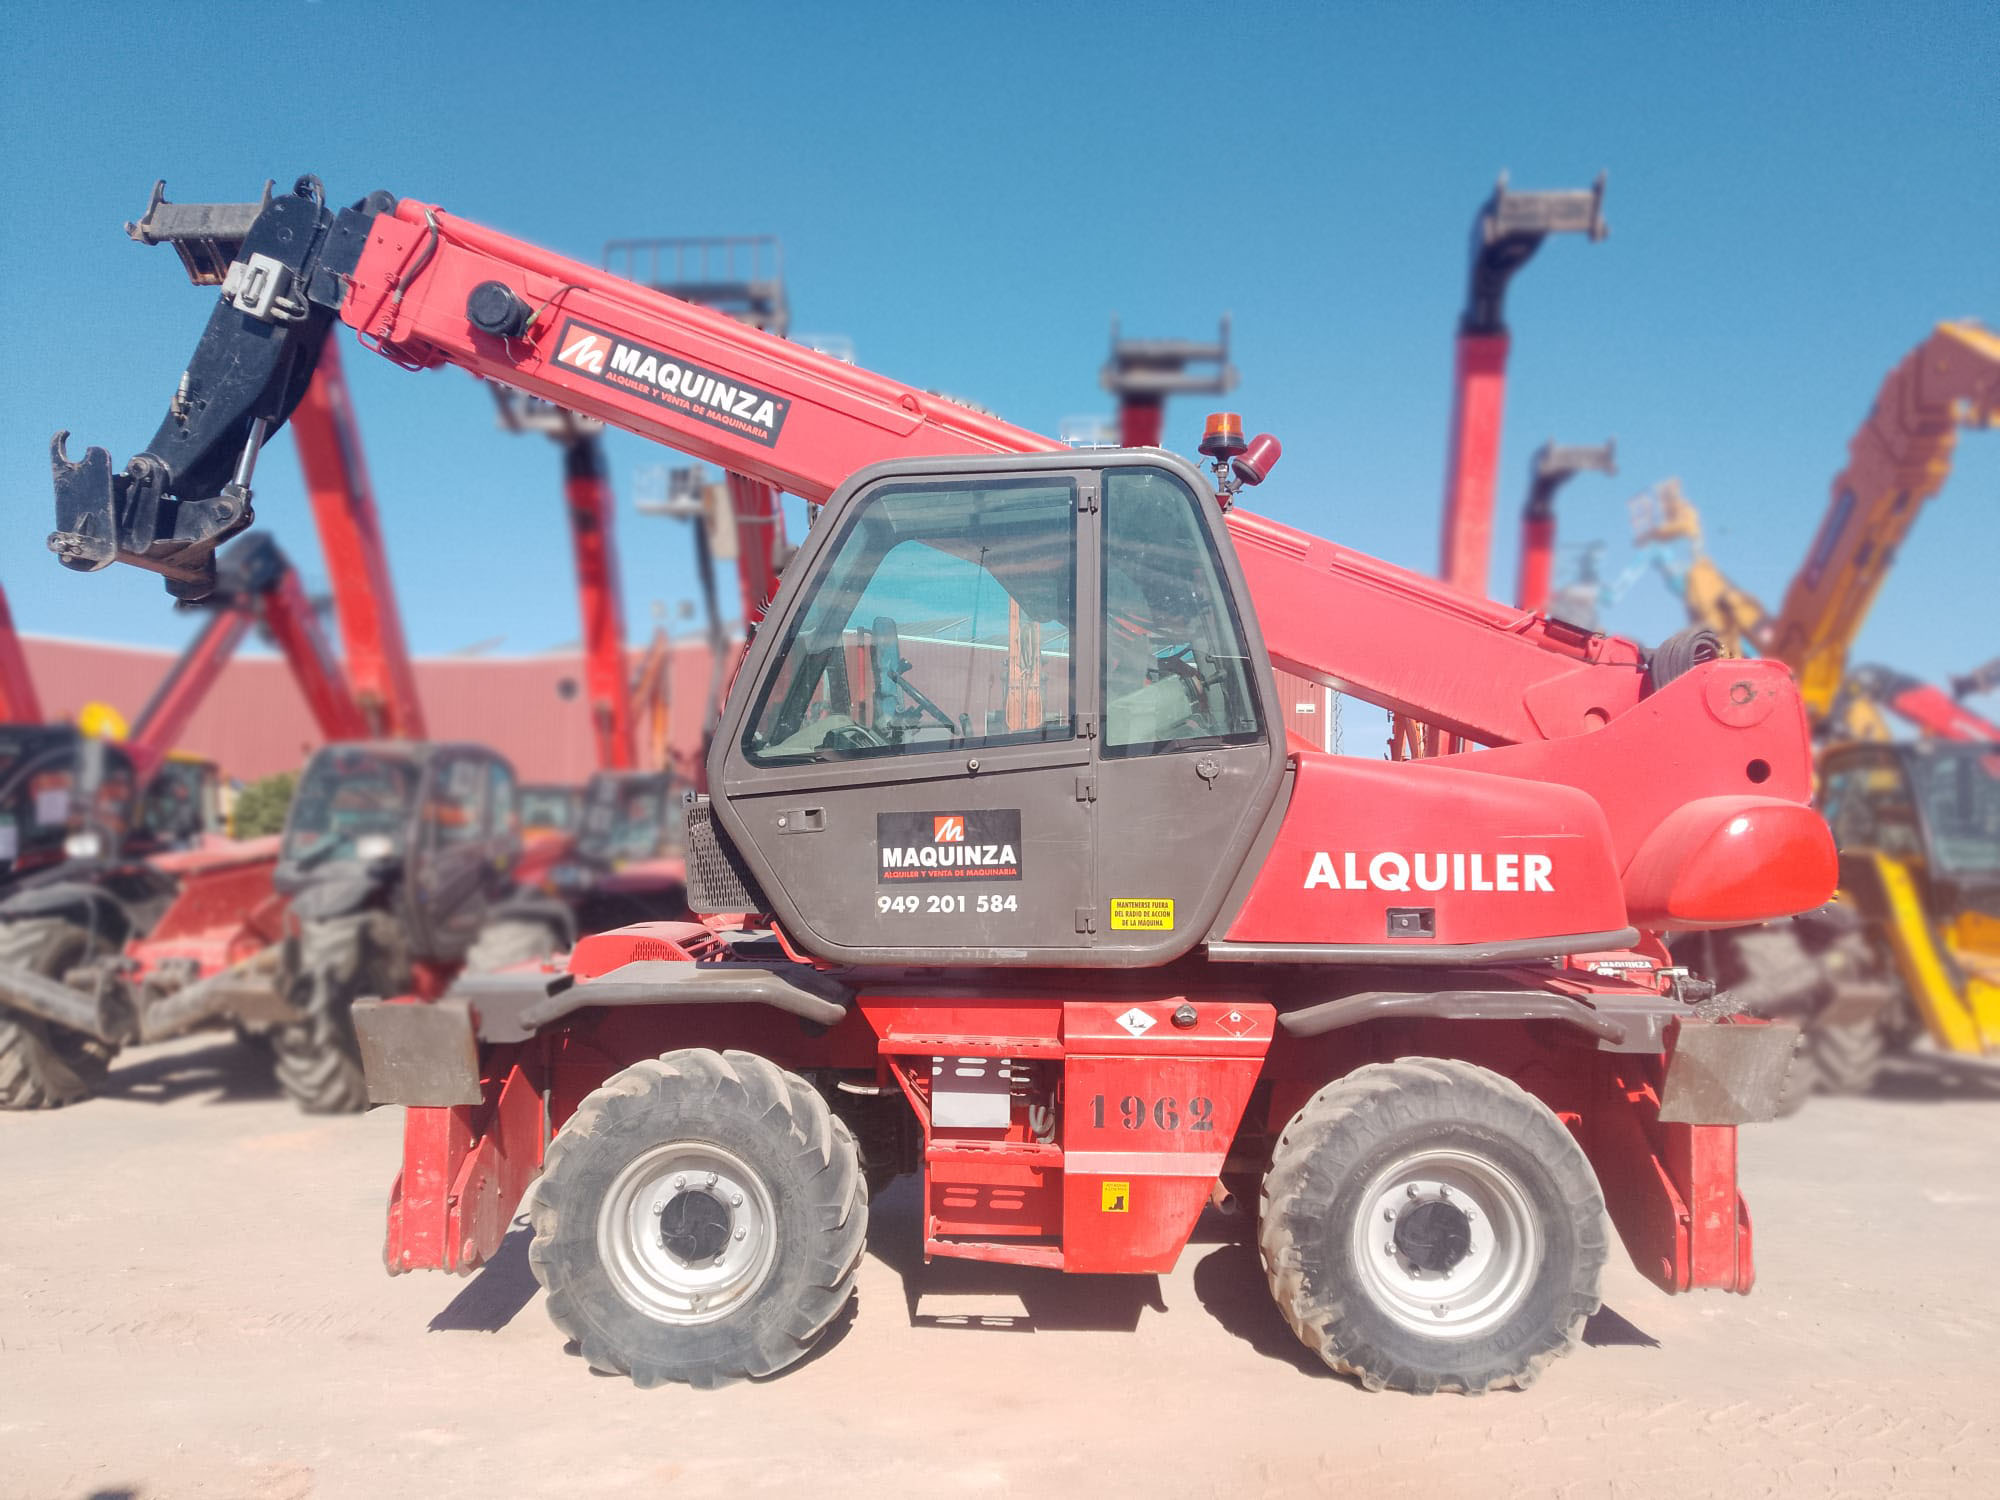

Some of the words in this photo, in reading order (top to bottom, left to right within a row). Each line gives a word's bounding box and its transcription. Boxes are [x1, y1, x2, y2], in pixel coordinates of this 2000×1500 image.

[610, 344, 774, 428] MAQUINZA
[605, 371, 650, 394] ALQUILER
[651, 388, 660, 398] Y
[661, 391, 690, 409] VENTA
[692, 403, 706, 415] DE
[706, 409, 768, 439] MAQUINARIA
[882, 844, 1017, 868] MAQUINZA
[883, 870, 919, 879] ALQUILER
[928, 869, 953, 877] VENTA
[954, 869, 965, 877] DE
[966, 867, 1017, 877] MAQUINARIA
[1303, 851, 1555, 892] ALQUILER
[877, 895, 920, 914] 949
[926, 895, 966, 913] 201
[976, 894, 1018, 913] 584
[1089, 1095, 1214, 1131] 1962
